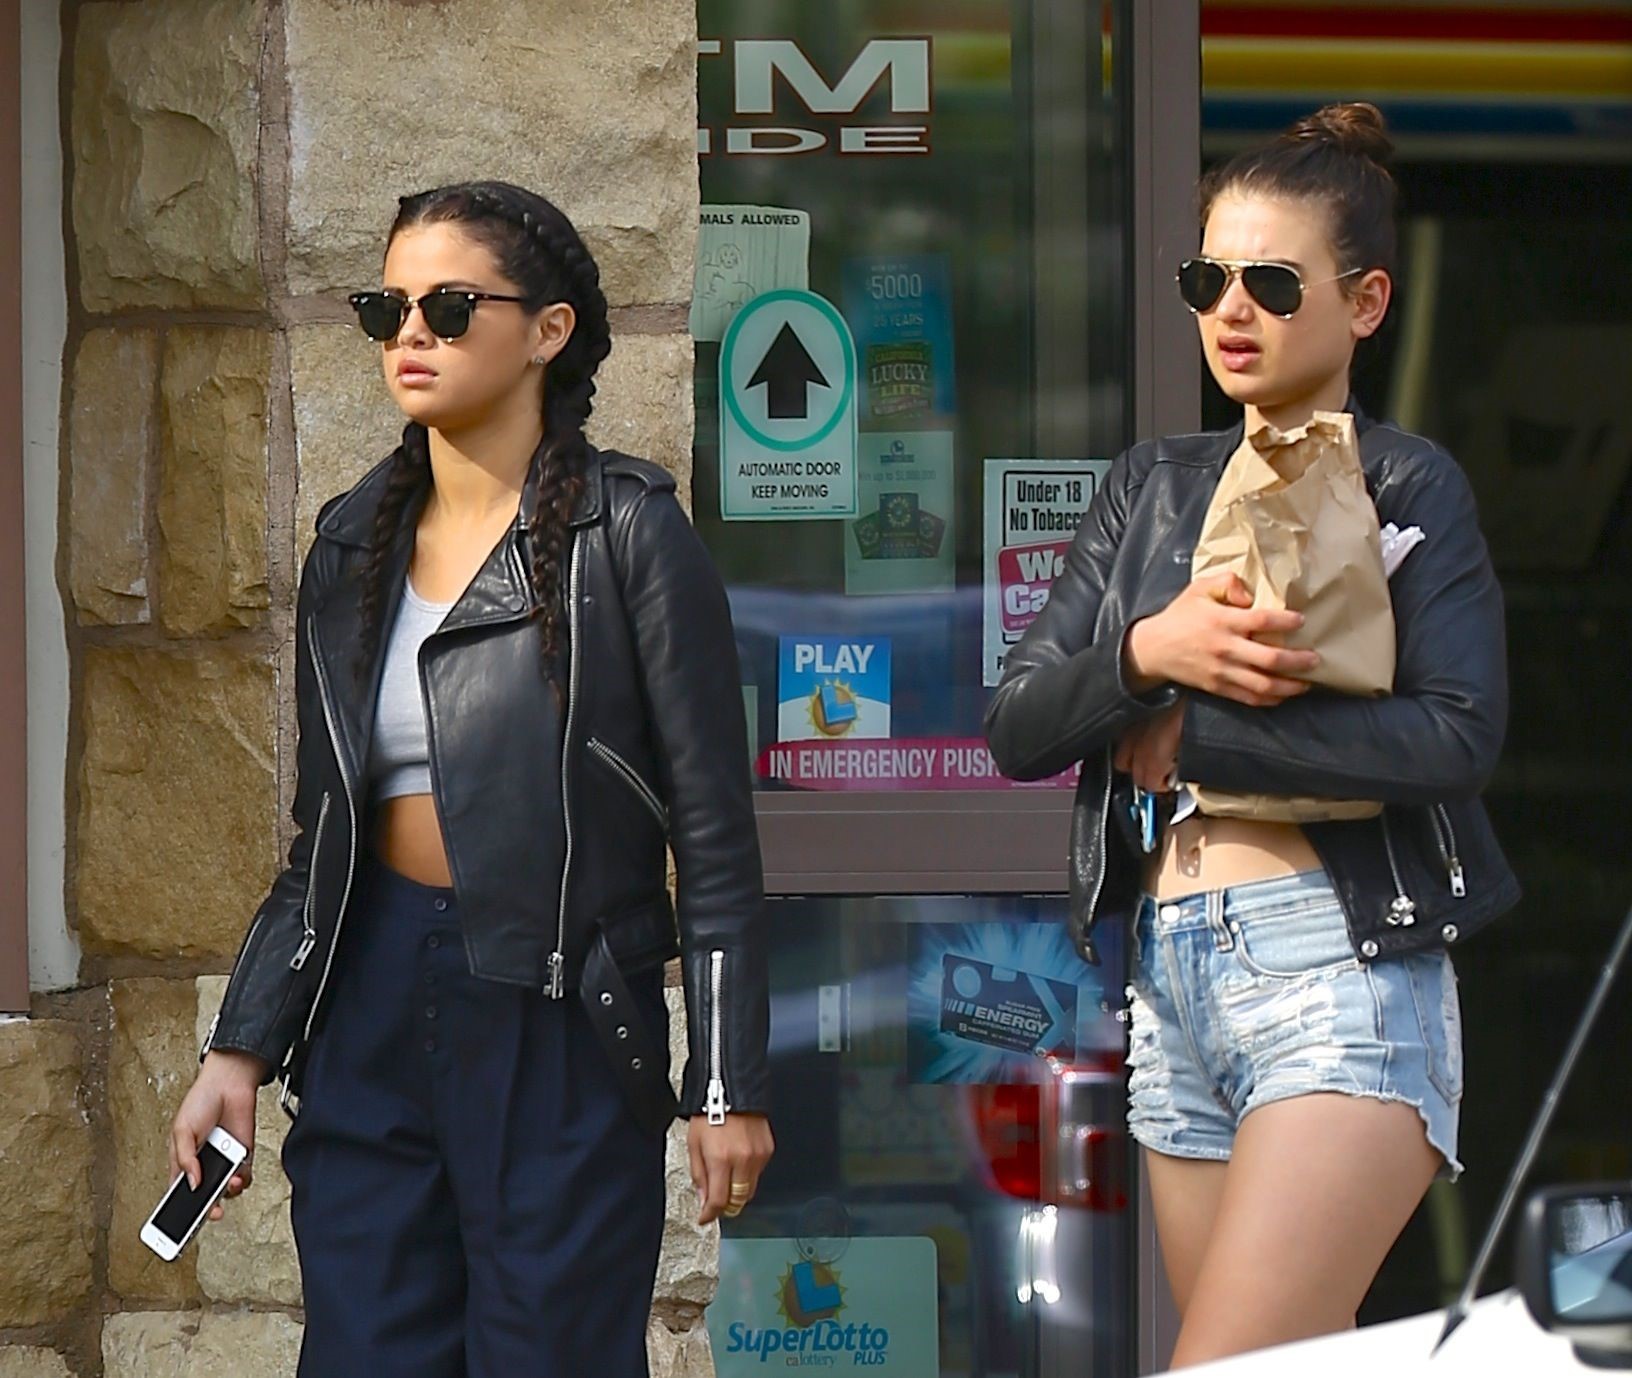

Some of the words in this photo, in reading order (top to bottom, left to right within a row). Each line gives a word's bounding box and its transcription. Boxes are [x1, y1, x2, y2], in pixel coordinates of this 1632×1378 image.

[697, 39, 930, 114] M
[741, 213, 800, 225] ALLOWED
[871, 363, 928, 384] LUCKY
[880, 384, 921, 397] LIFE
[738, 462, 802, 477] AUTOMATIC
[806, 462, 841, 475] DOOR
[751, 485, 778, 498] KEEP
[780, 484, 828, 498] MOVING
[1017, 480, 1061, 502] Under
[1065, 481, 1082, 502] 18
[1010, 508, 1028, 531] No
[1031, 508, 1087, 531] Tobacc
[795, 644, 875, 674] PLAY
[769, 750, 792, 778] IN
[800, 749, 936, 778] EMERGENCY
[974, 1006, 1050, 1033] ENERGY
[726, 1319, 889, 1362] SuperLotto
[853, 1351, 886, 1365] PLUS
